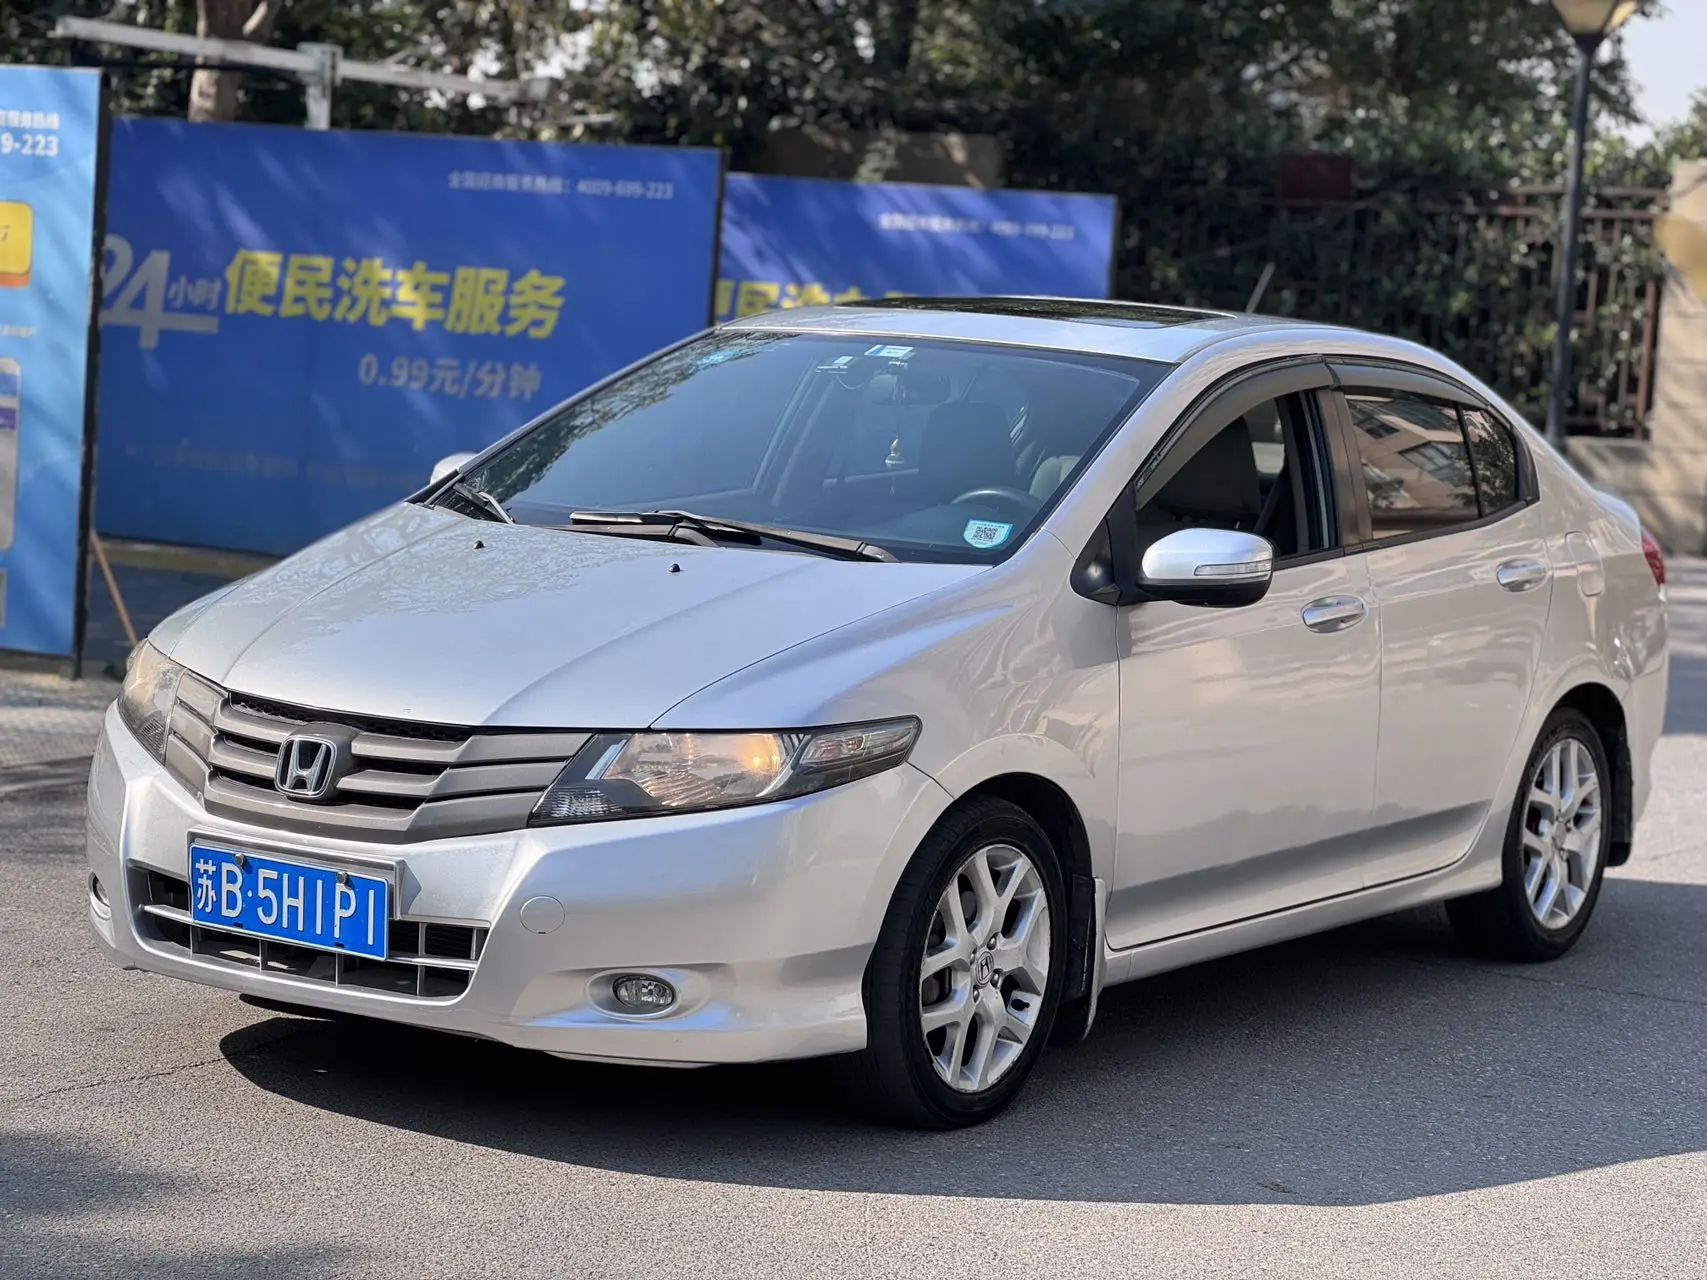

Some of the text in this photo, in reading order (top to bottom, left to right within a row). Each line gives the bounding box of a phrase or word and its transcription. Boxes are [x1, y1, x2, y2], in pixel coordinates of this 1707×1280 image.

[224, 248, 566, 339] 便民洗车服务
[358, 353, 543, 401] 0.99元/分钟
